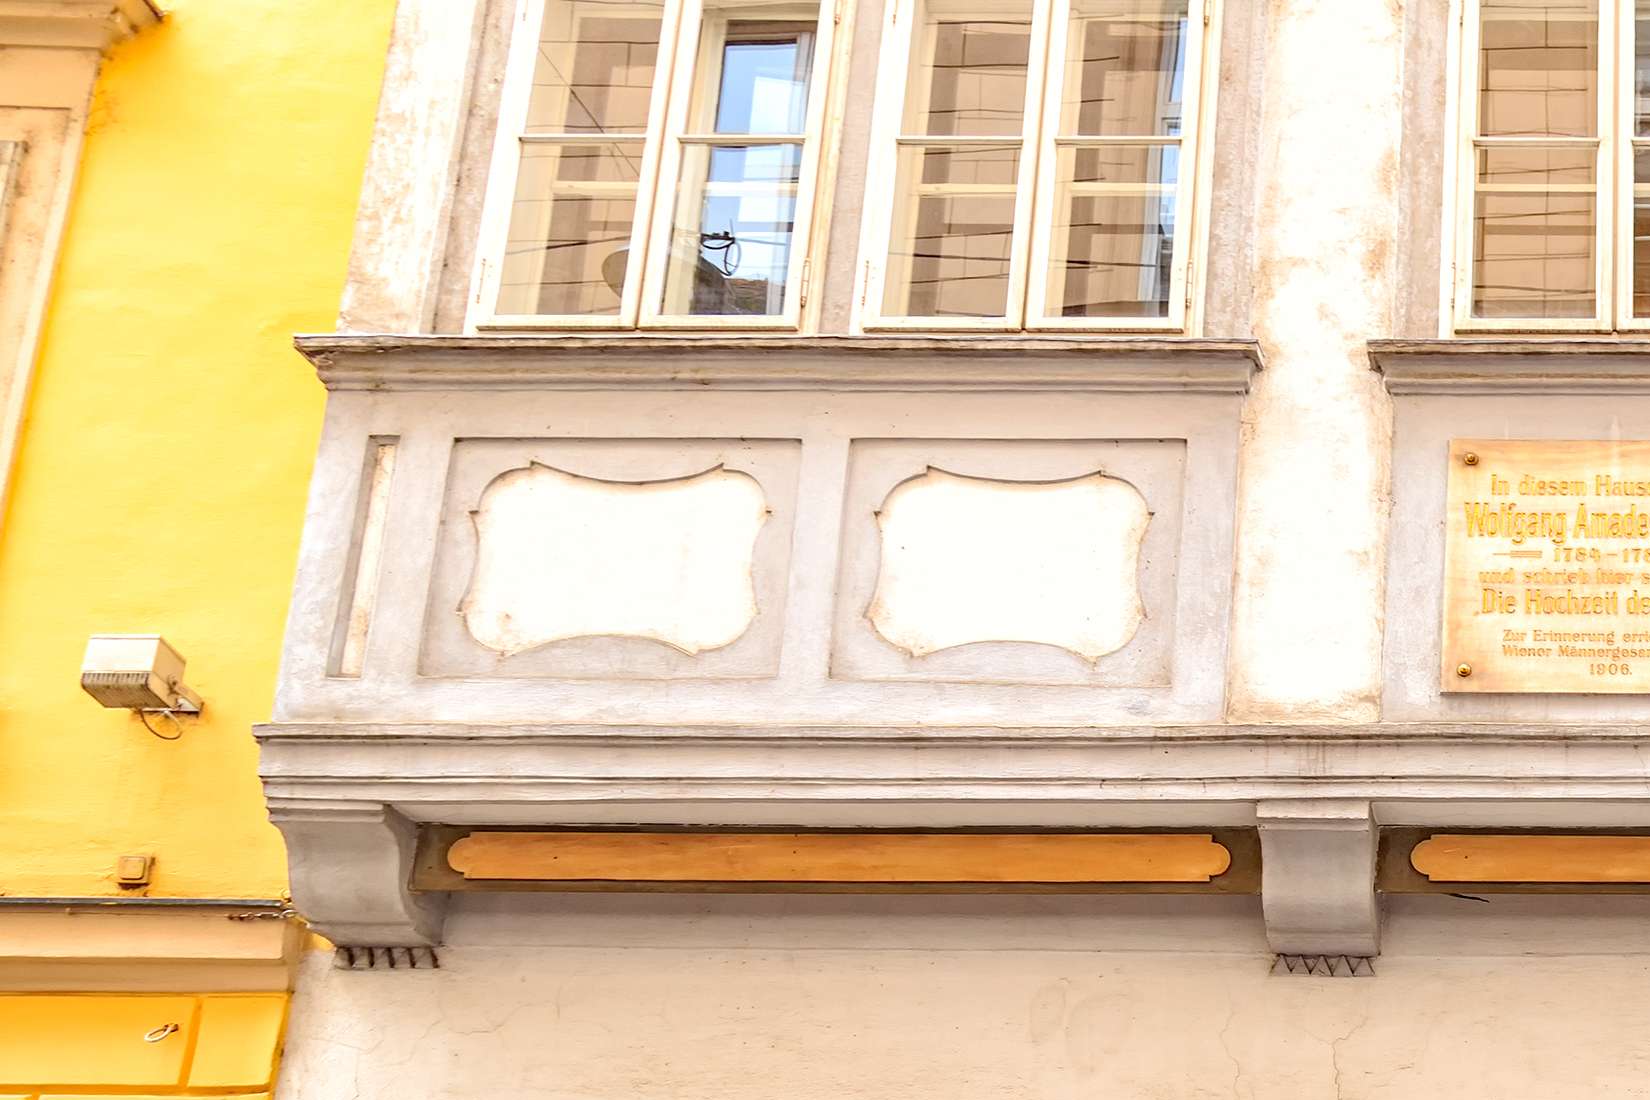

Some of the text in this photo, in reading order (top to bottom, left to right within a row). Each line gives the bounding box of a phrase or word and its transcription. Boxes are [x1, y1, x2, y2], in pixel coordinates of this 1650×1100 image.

[1491, 473, 1510, 496] In
[1519, 473, 1587, 497] diesem
[1464, 501, 1567, 545] Wolfgang
[1478, 567, 1515, 584] und
[1522, 567, 1589, 585] schrieb
[1596, 567, 1634, 585] hier
[1524, 588, 1618, 616] Hochzeit
[1502, 629, 1527, 642] Zur
[1532, 629, 1616, 646] Erinnerung
[1502, 644, 1553, 657] Wiener
